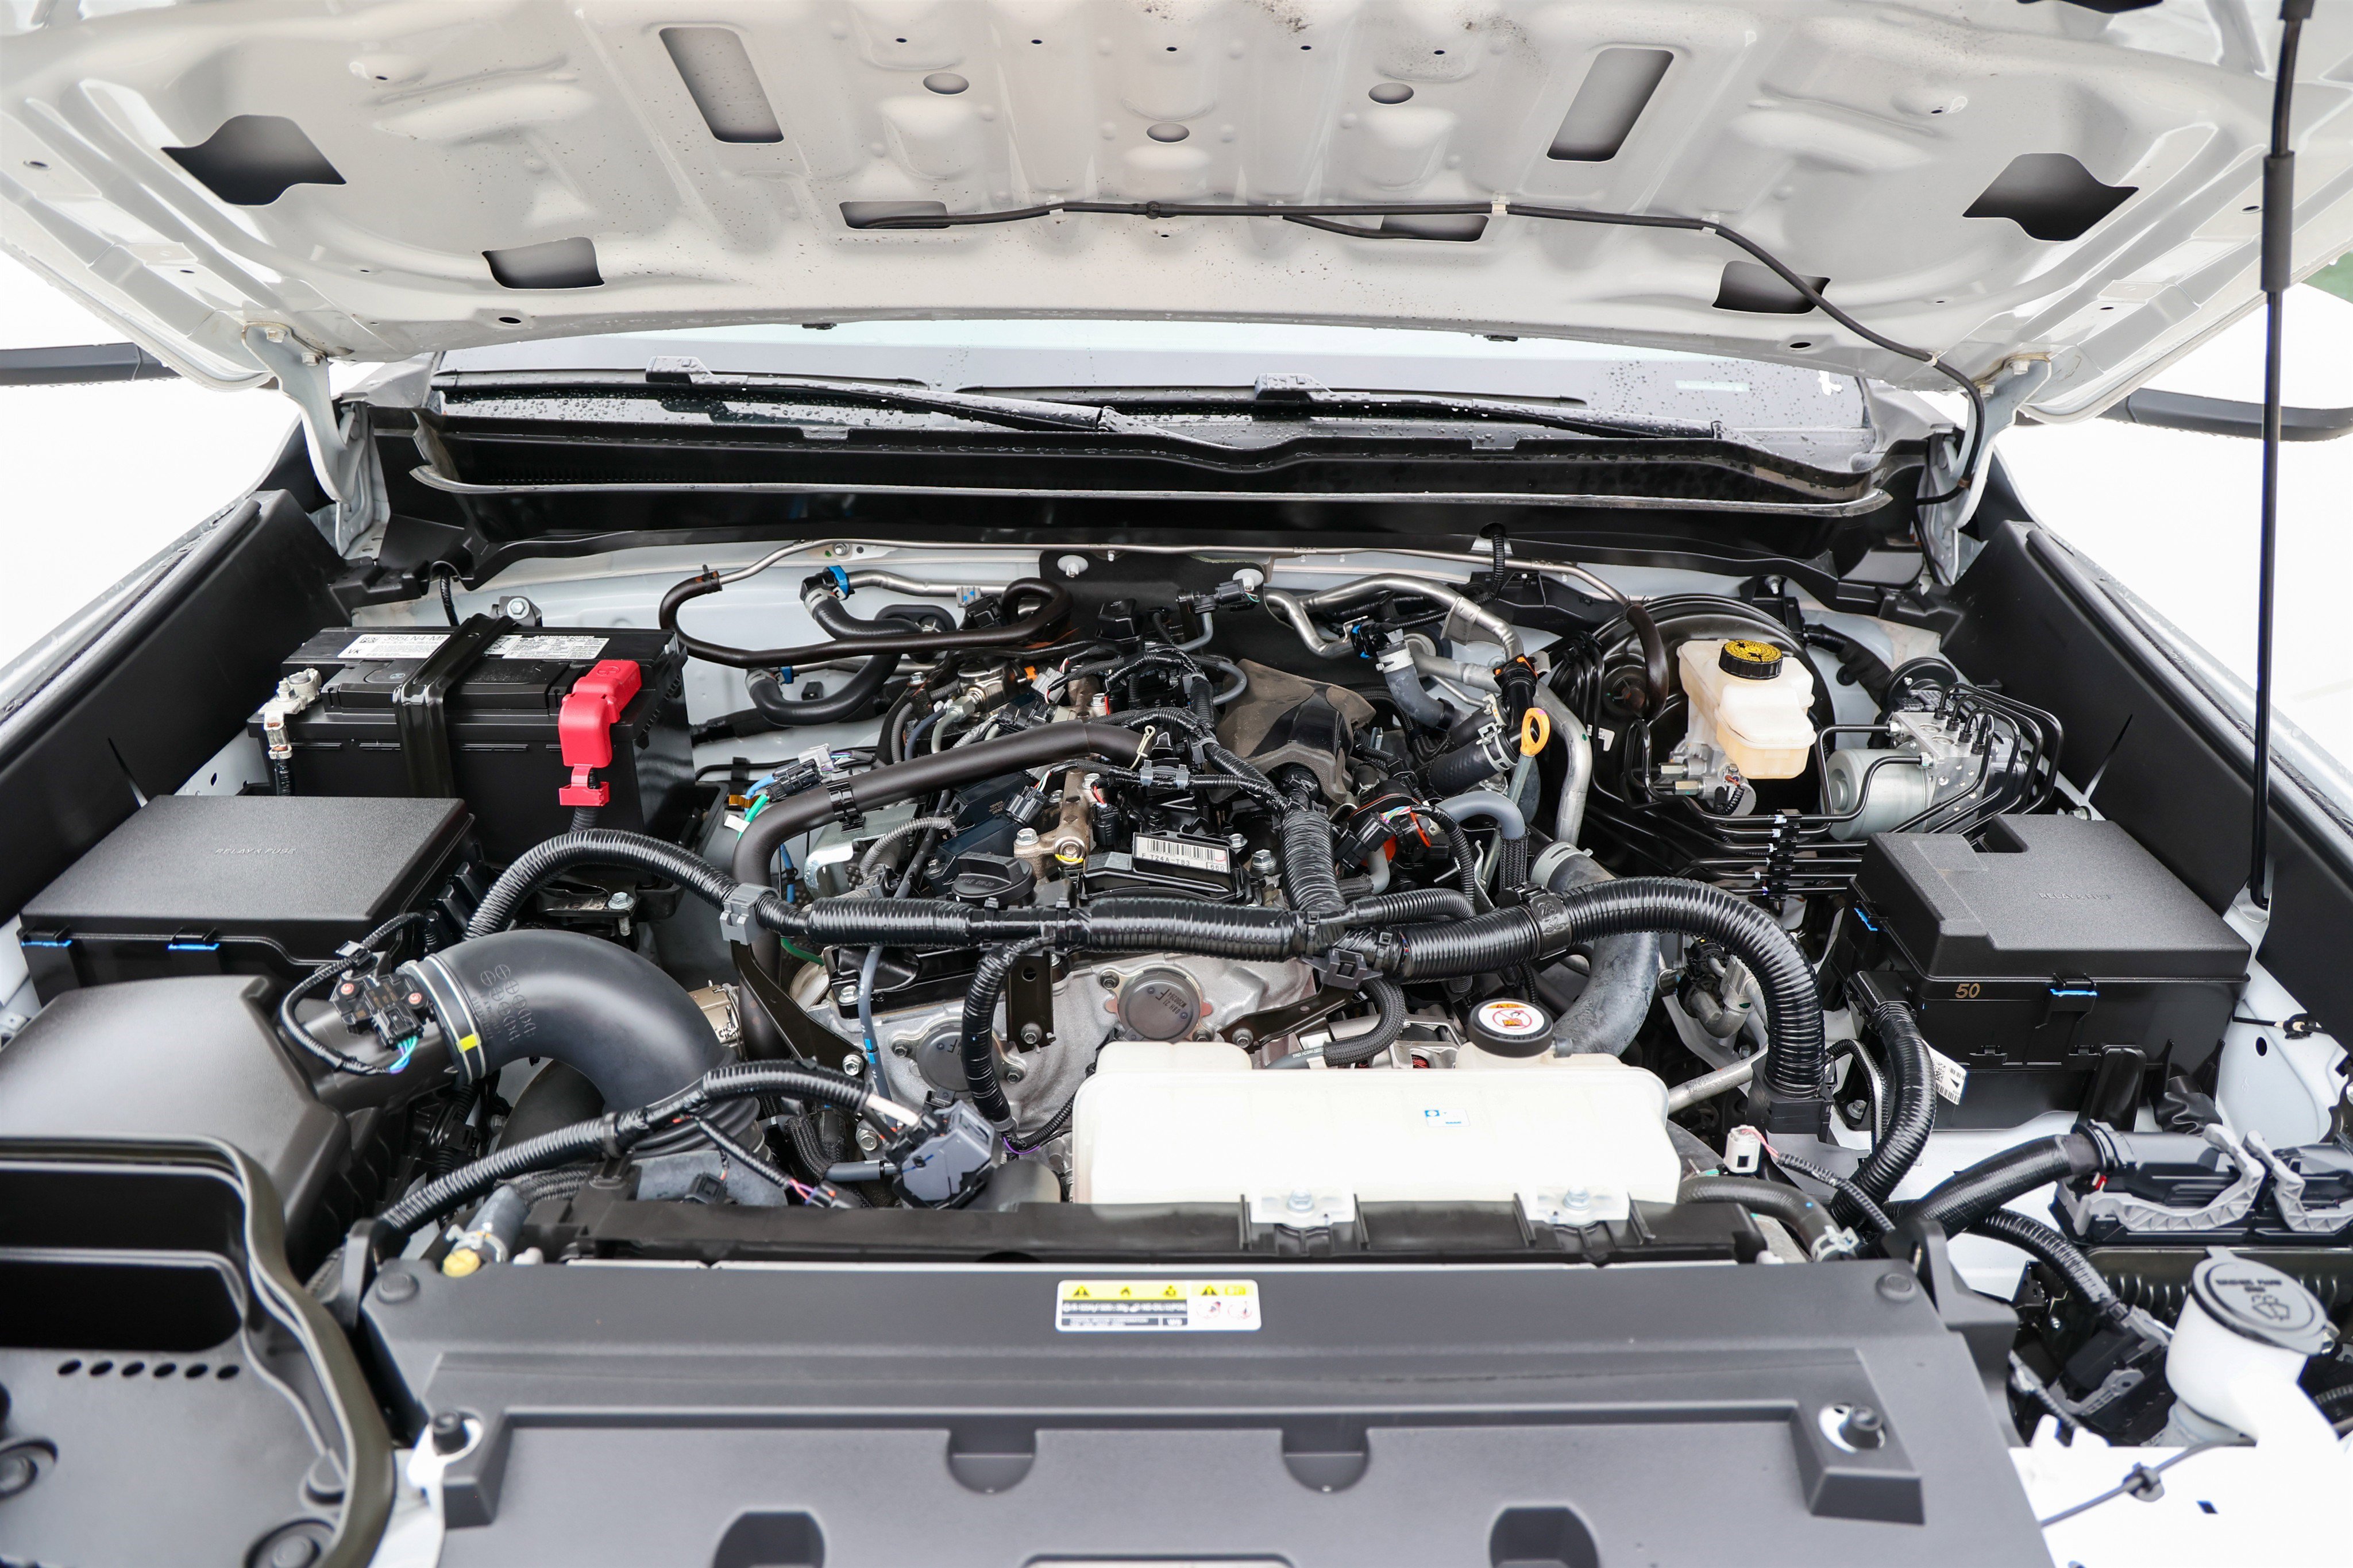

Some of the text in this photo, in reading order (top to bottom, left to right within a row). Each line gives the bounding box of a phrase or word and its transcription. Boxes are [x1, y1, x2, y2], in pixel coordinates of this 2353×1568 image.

[989, 800, 1004, 809] TOYOTA
[1150, 854, 1190, 866] T24A-T83
[1210, 864, 1225, 872] 660
[1955, 983, 1981, 999] 50
